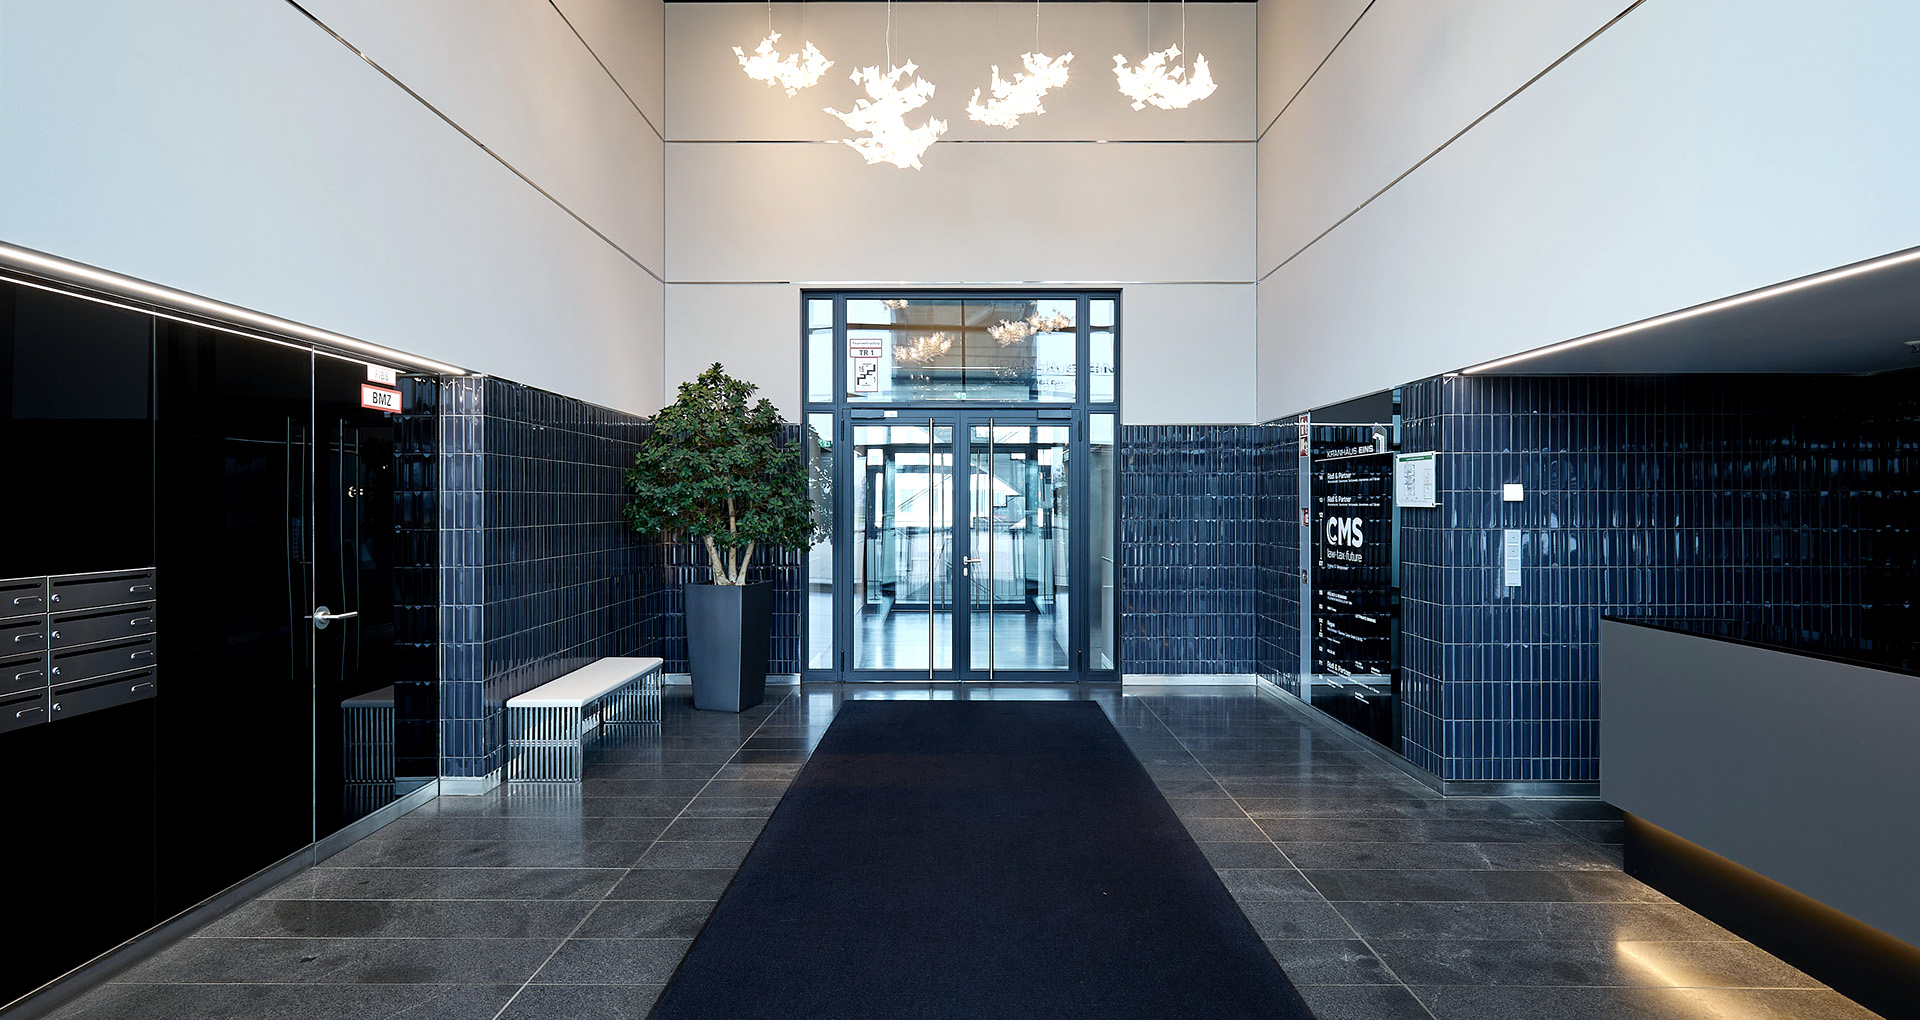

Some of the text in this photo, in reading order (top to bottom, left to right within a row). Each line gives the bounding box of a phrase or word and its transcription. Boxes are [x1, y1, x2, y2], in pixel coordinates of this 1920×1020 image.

[372, 391, 392, 407] BMZ
[1326, 444, 1374, 458] KRANHAUS EINS
[1326, 516, 1363, 548] CMS
